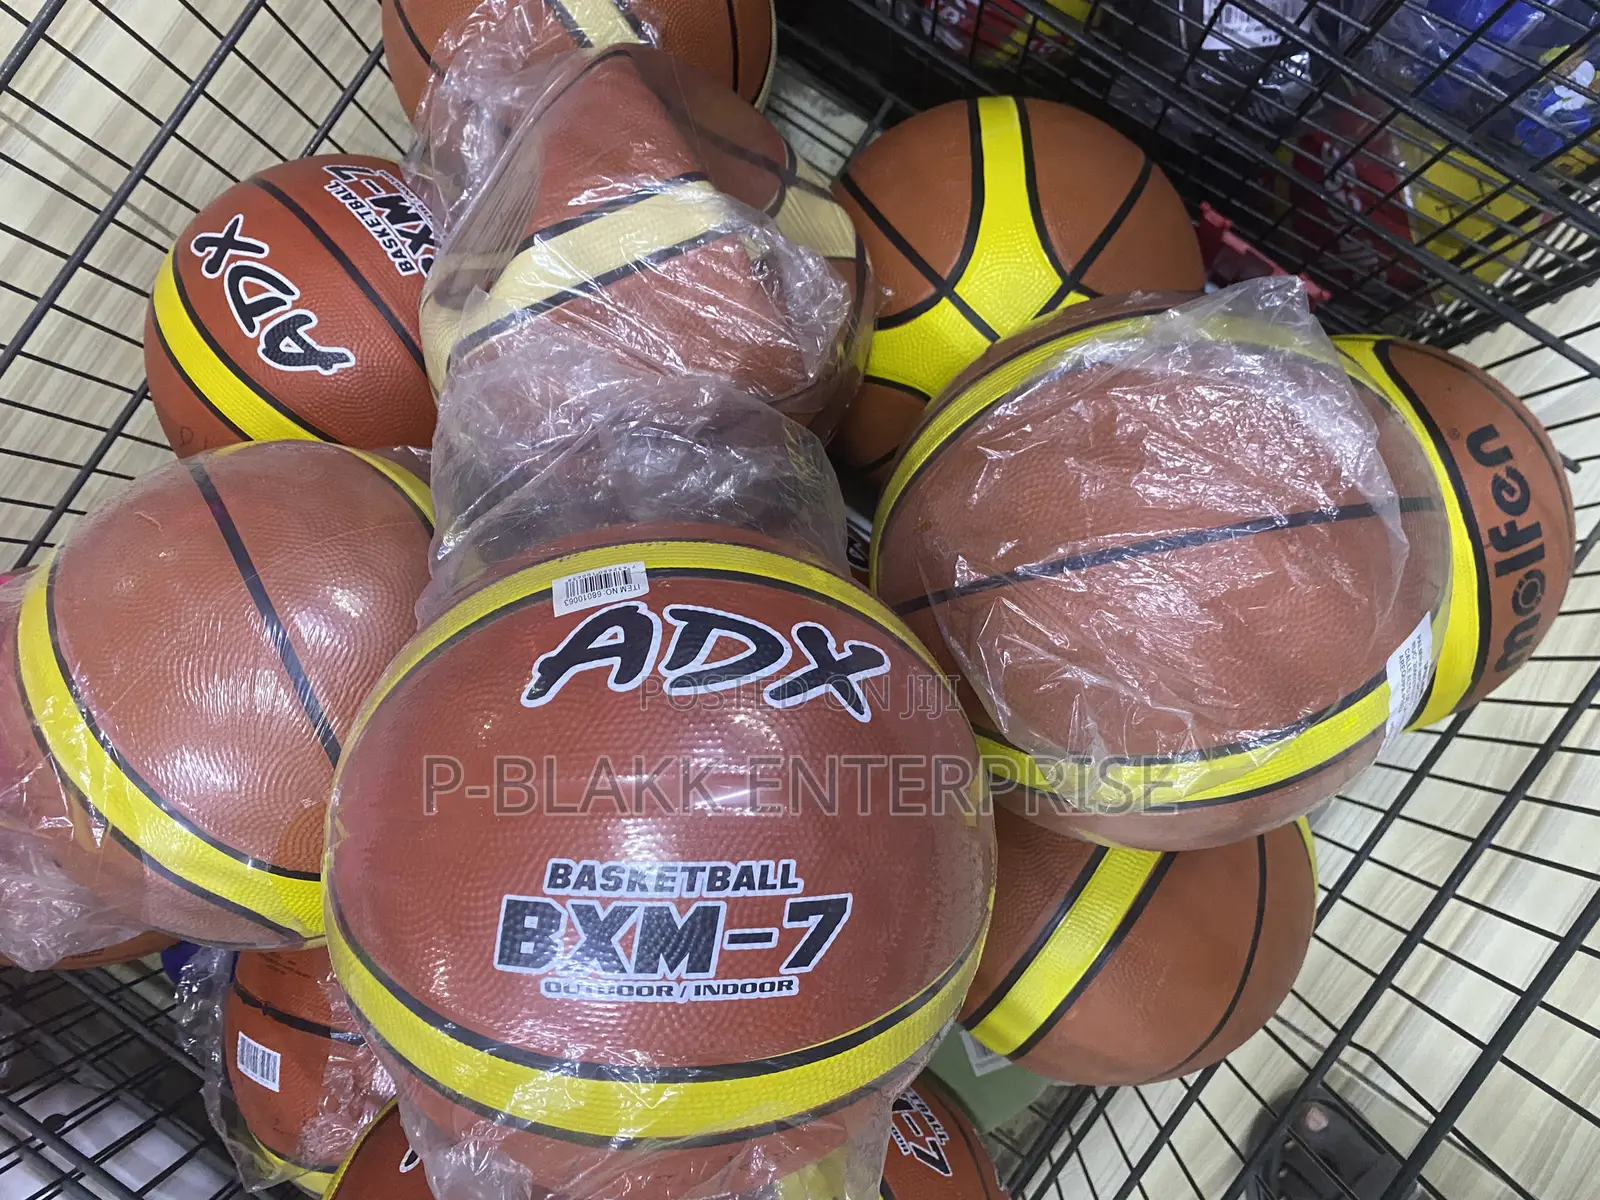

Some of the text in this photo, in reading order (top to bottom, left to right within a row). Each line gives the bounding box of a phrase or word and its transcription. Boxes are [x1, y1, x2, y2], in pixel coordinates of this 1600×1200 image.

[324, 178, 419, 276] BASKETBALL
[191, 214, 356, 376] ADX
[603, 588, 618, 596] NO:
[620, 584, 641, 593] ITEM
[520, 600, 891, 723] ADX
[544, 859, 803, 897] BASKETBALL
[494, 893, 853, 979] BXM-7
[692, 977, 797, 998] INDOOR
